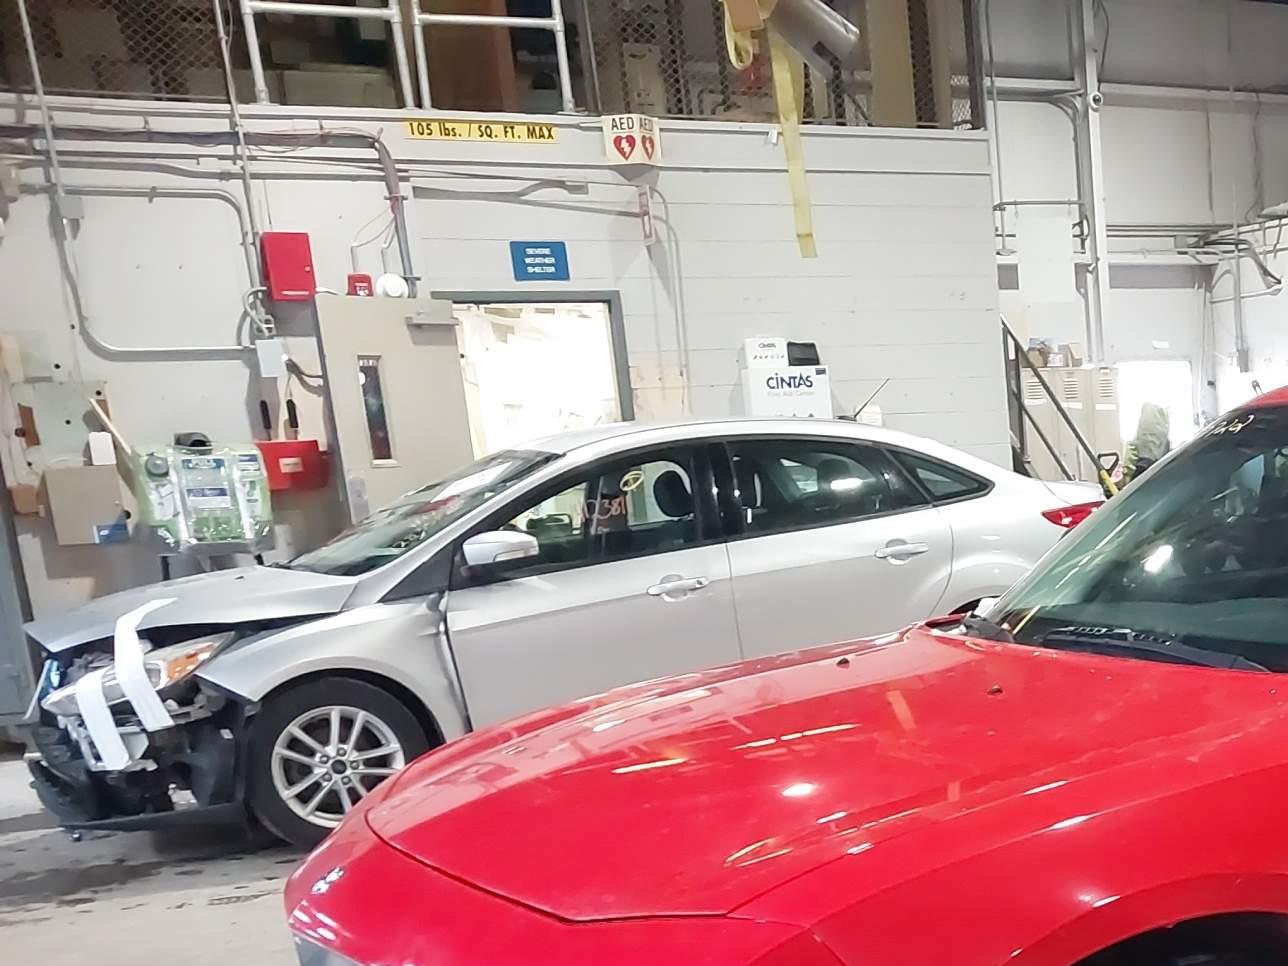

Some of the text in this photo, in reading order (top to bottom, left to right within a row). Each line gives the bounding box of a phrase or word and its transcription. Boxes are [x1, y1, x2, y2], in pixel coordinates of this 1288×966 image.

[409, 122, 554, 140] 105 lbs. / SQ. FT. MAX
[611, 116, 634, 131] AED
[640, 116, 654, 131] AED
